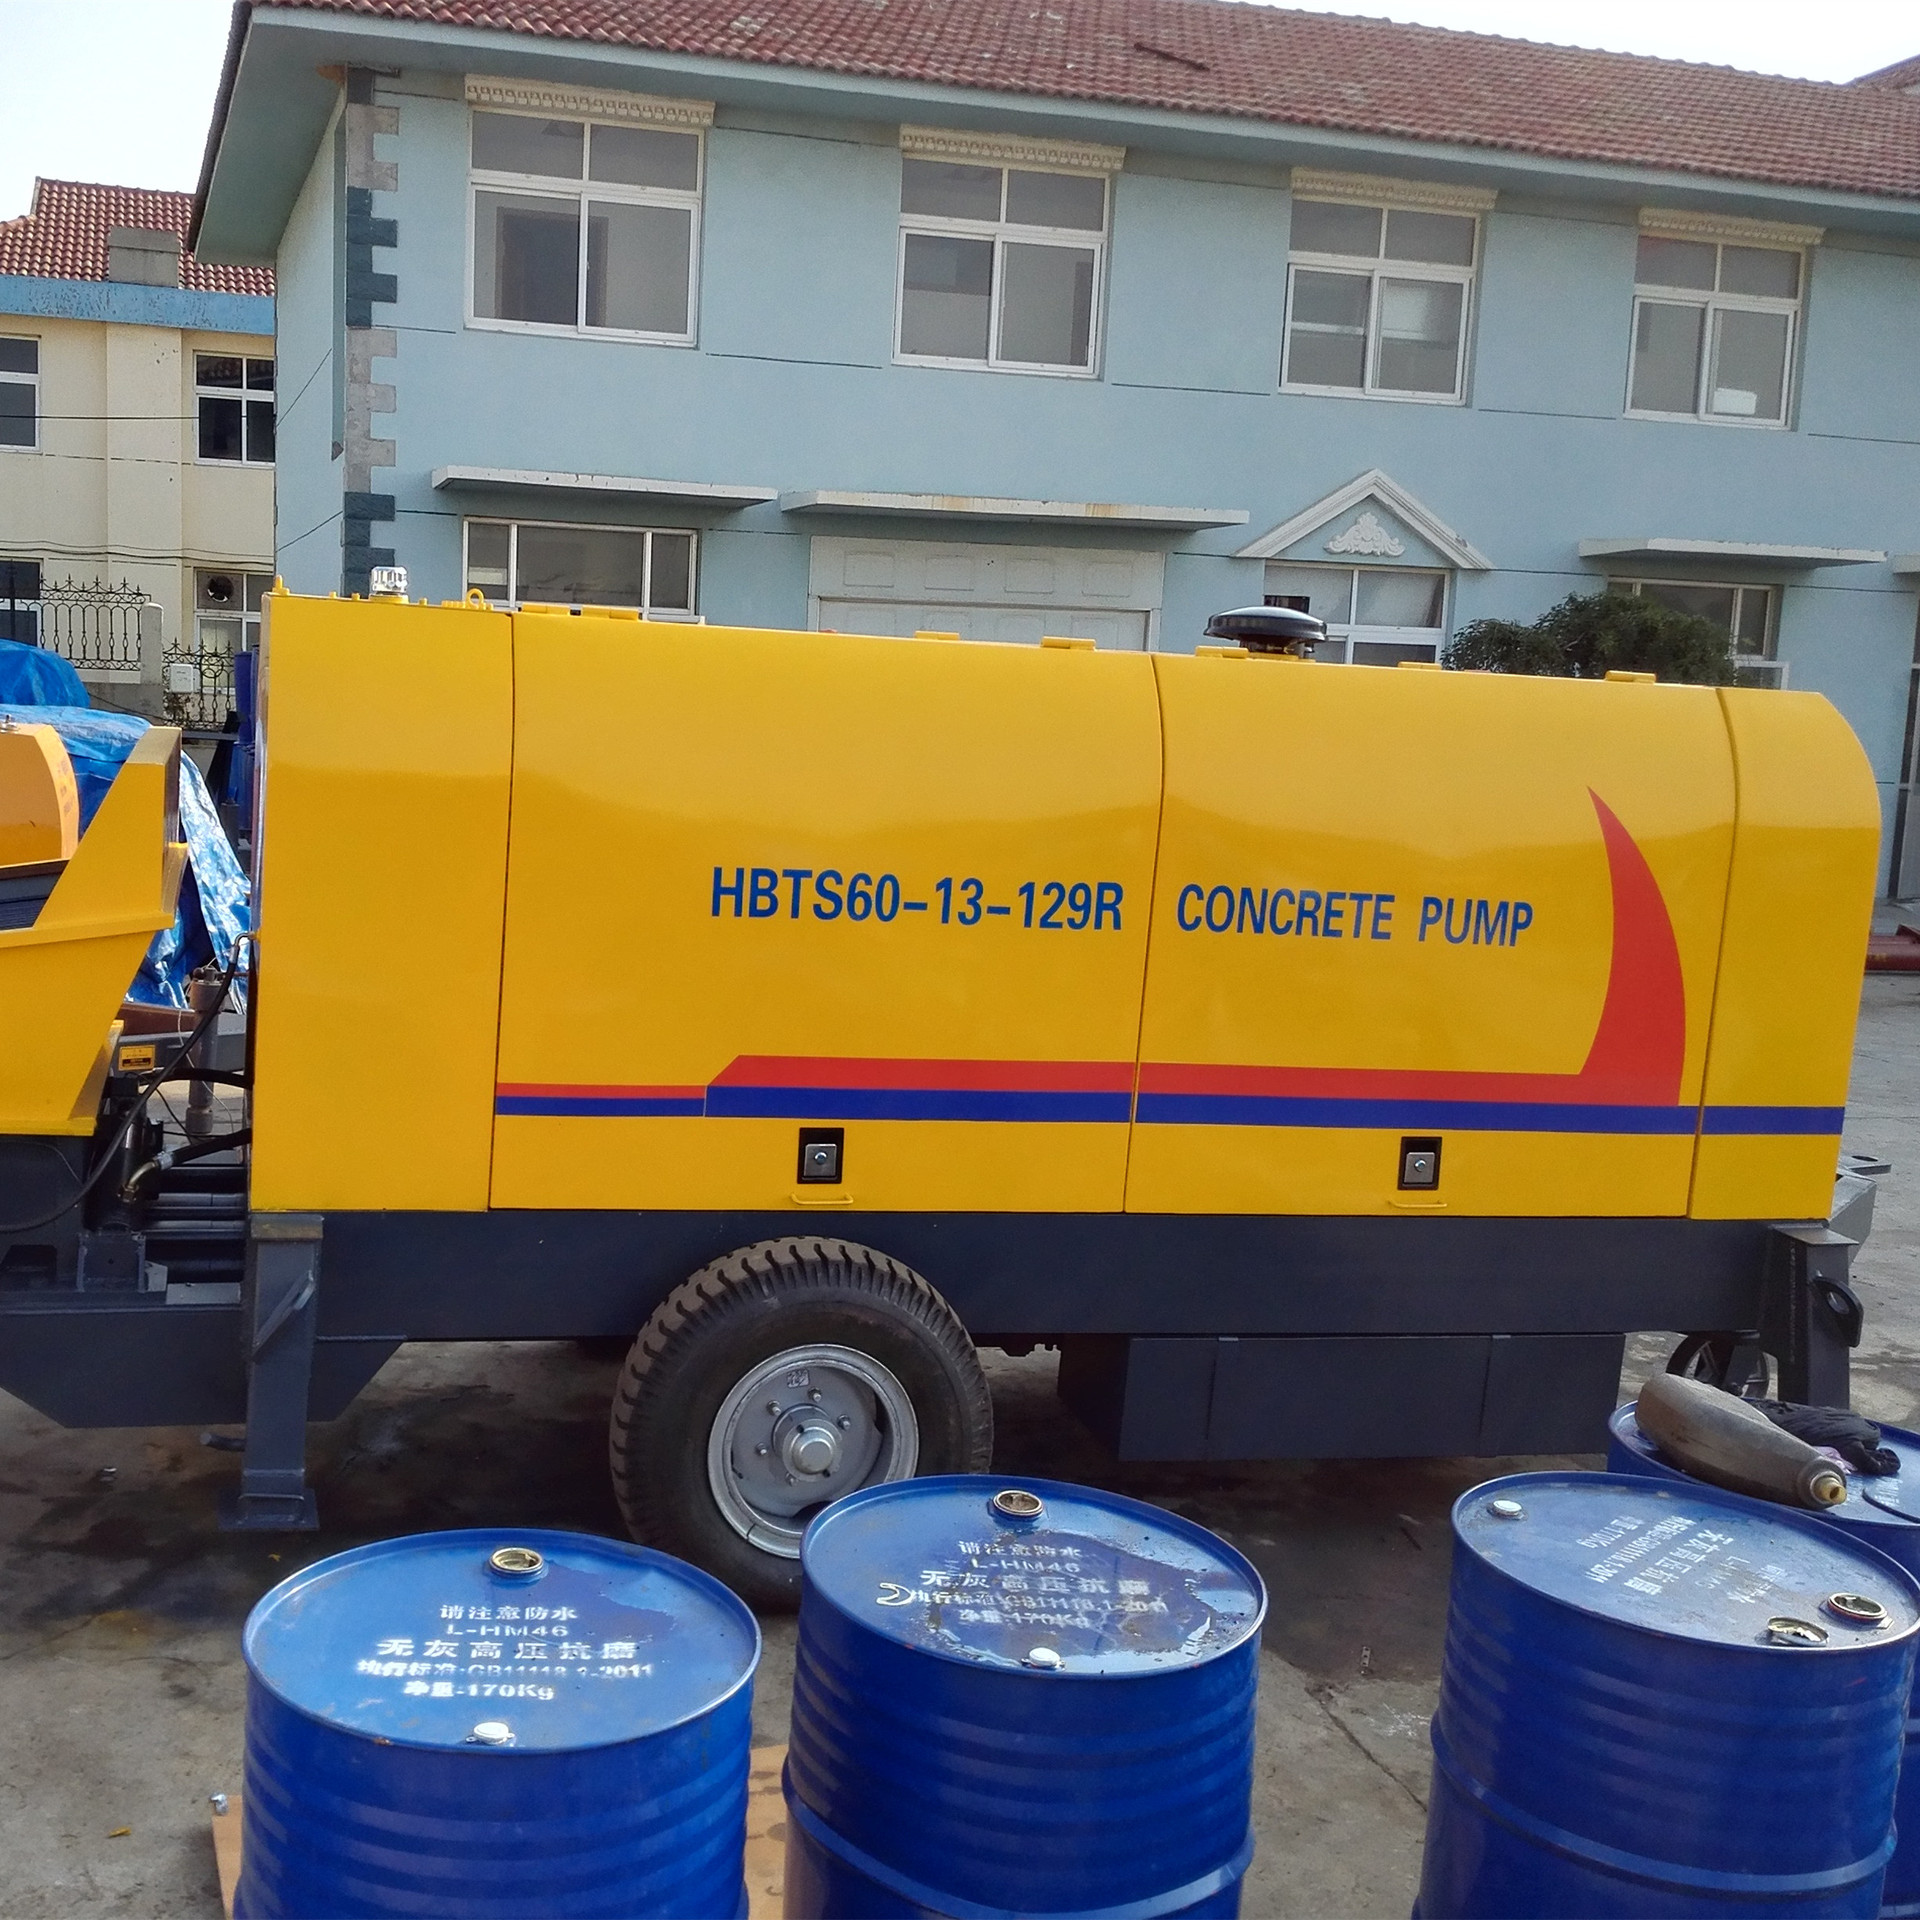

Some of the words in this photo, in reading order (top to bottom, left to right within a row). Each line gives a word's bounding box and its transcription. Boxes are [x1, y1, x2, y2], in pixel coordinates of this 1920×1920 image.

[711, 866, 1124, 931] HBTS60-13-129R
[1176, 883, 1395, 940] CONCRETE
[1418, 895, 1534, 947] PUMP
[440, 1604, 578, 1621] 请注意防水
[446, 1624, 569, 1637] L-HM46
[376, 1639, 637, 1660] 无灰高压抗磨
